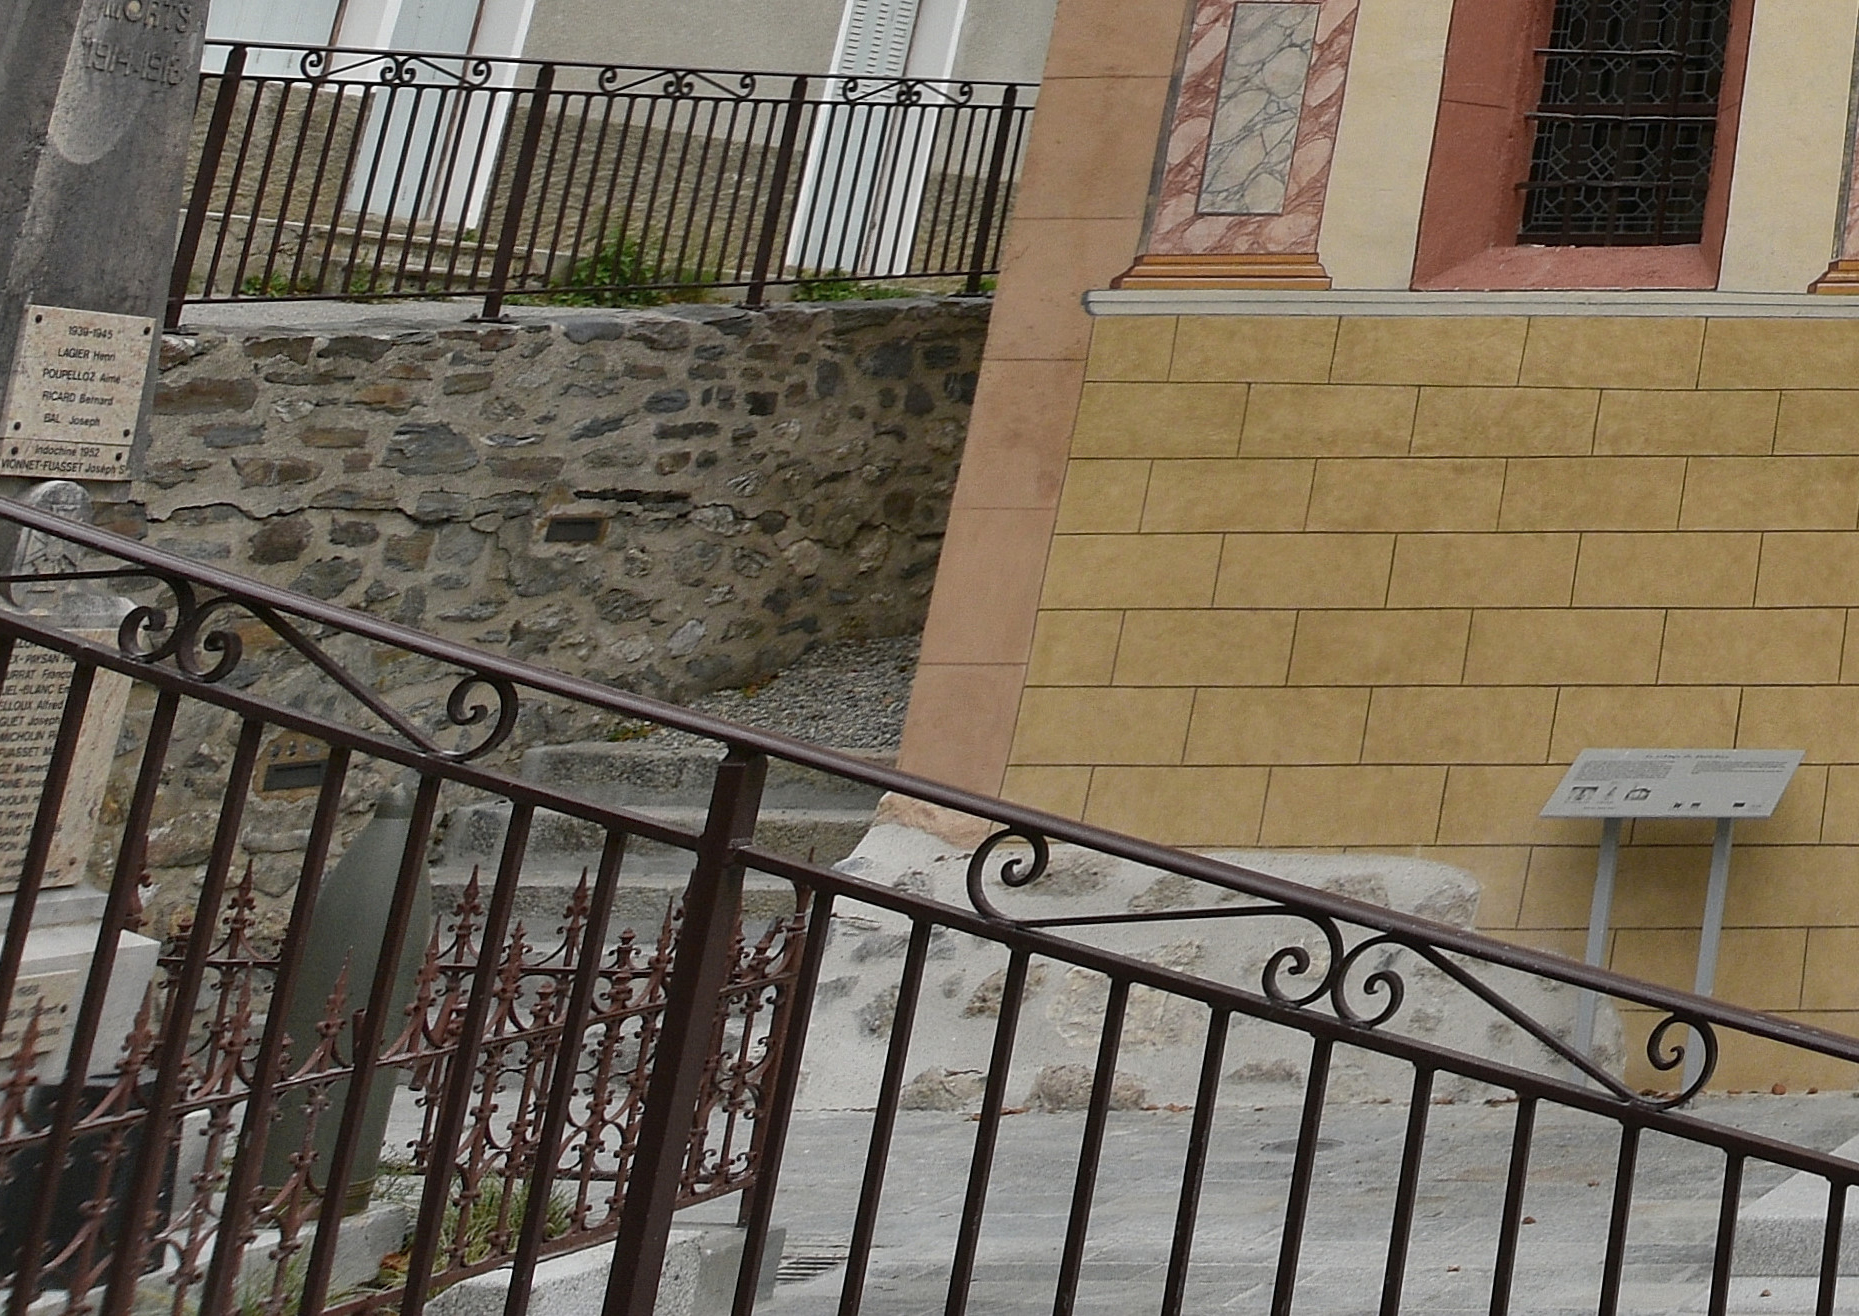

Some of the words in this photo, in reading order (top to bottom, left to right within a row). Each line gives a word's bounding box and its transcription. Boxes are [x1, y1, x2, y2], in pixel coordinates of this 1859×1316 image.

[68, 325, 114, 339] 1939-1945
[42, 390, 76, 404] RICARD
[79, 393, 115, 406] Bernard
[68, 417, 101, 428] Joseph
